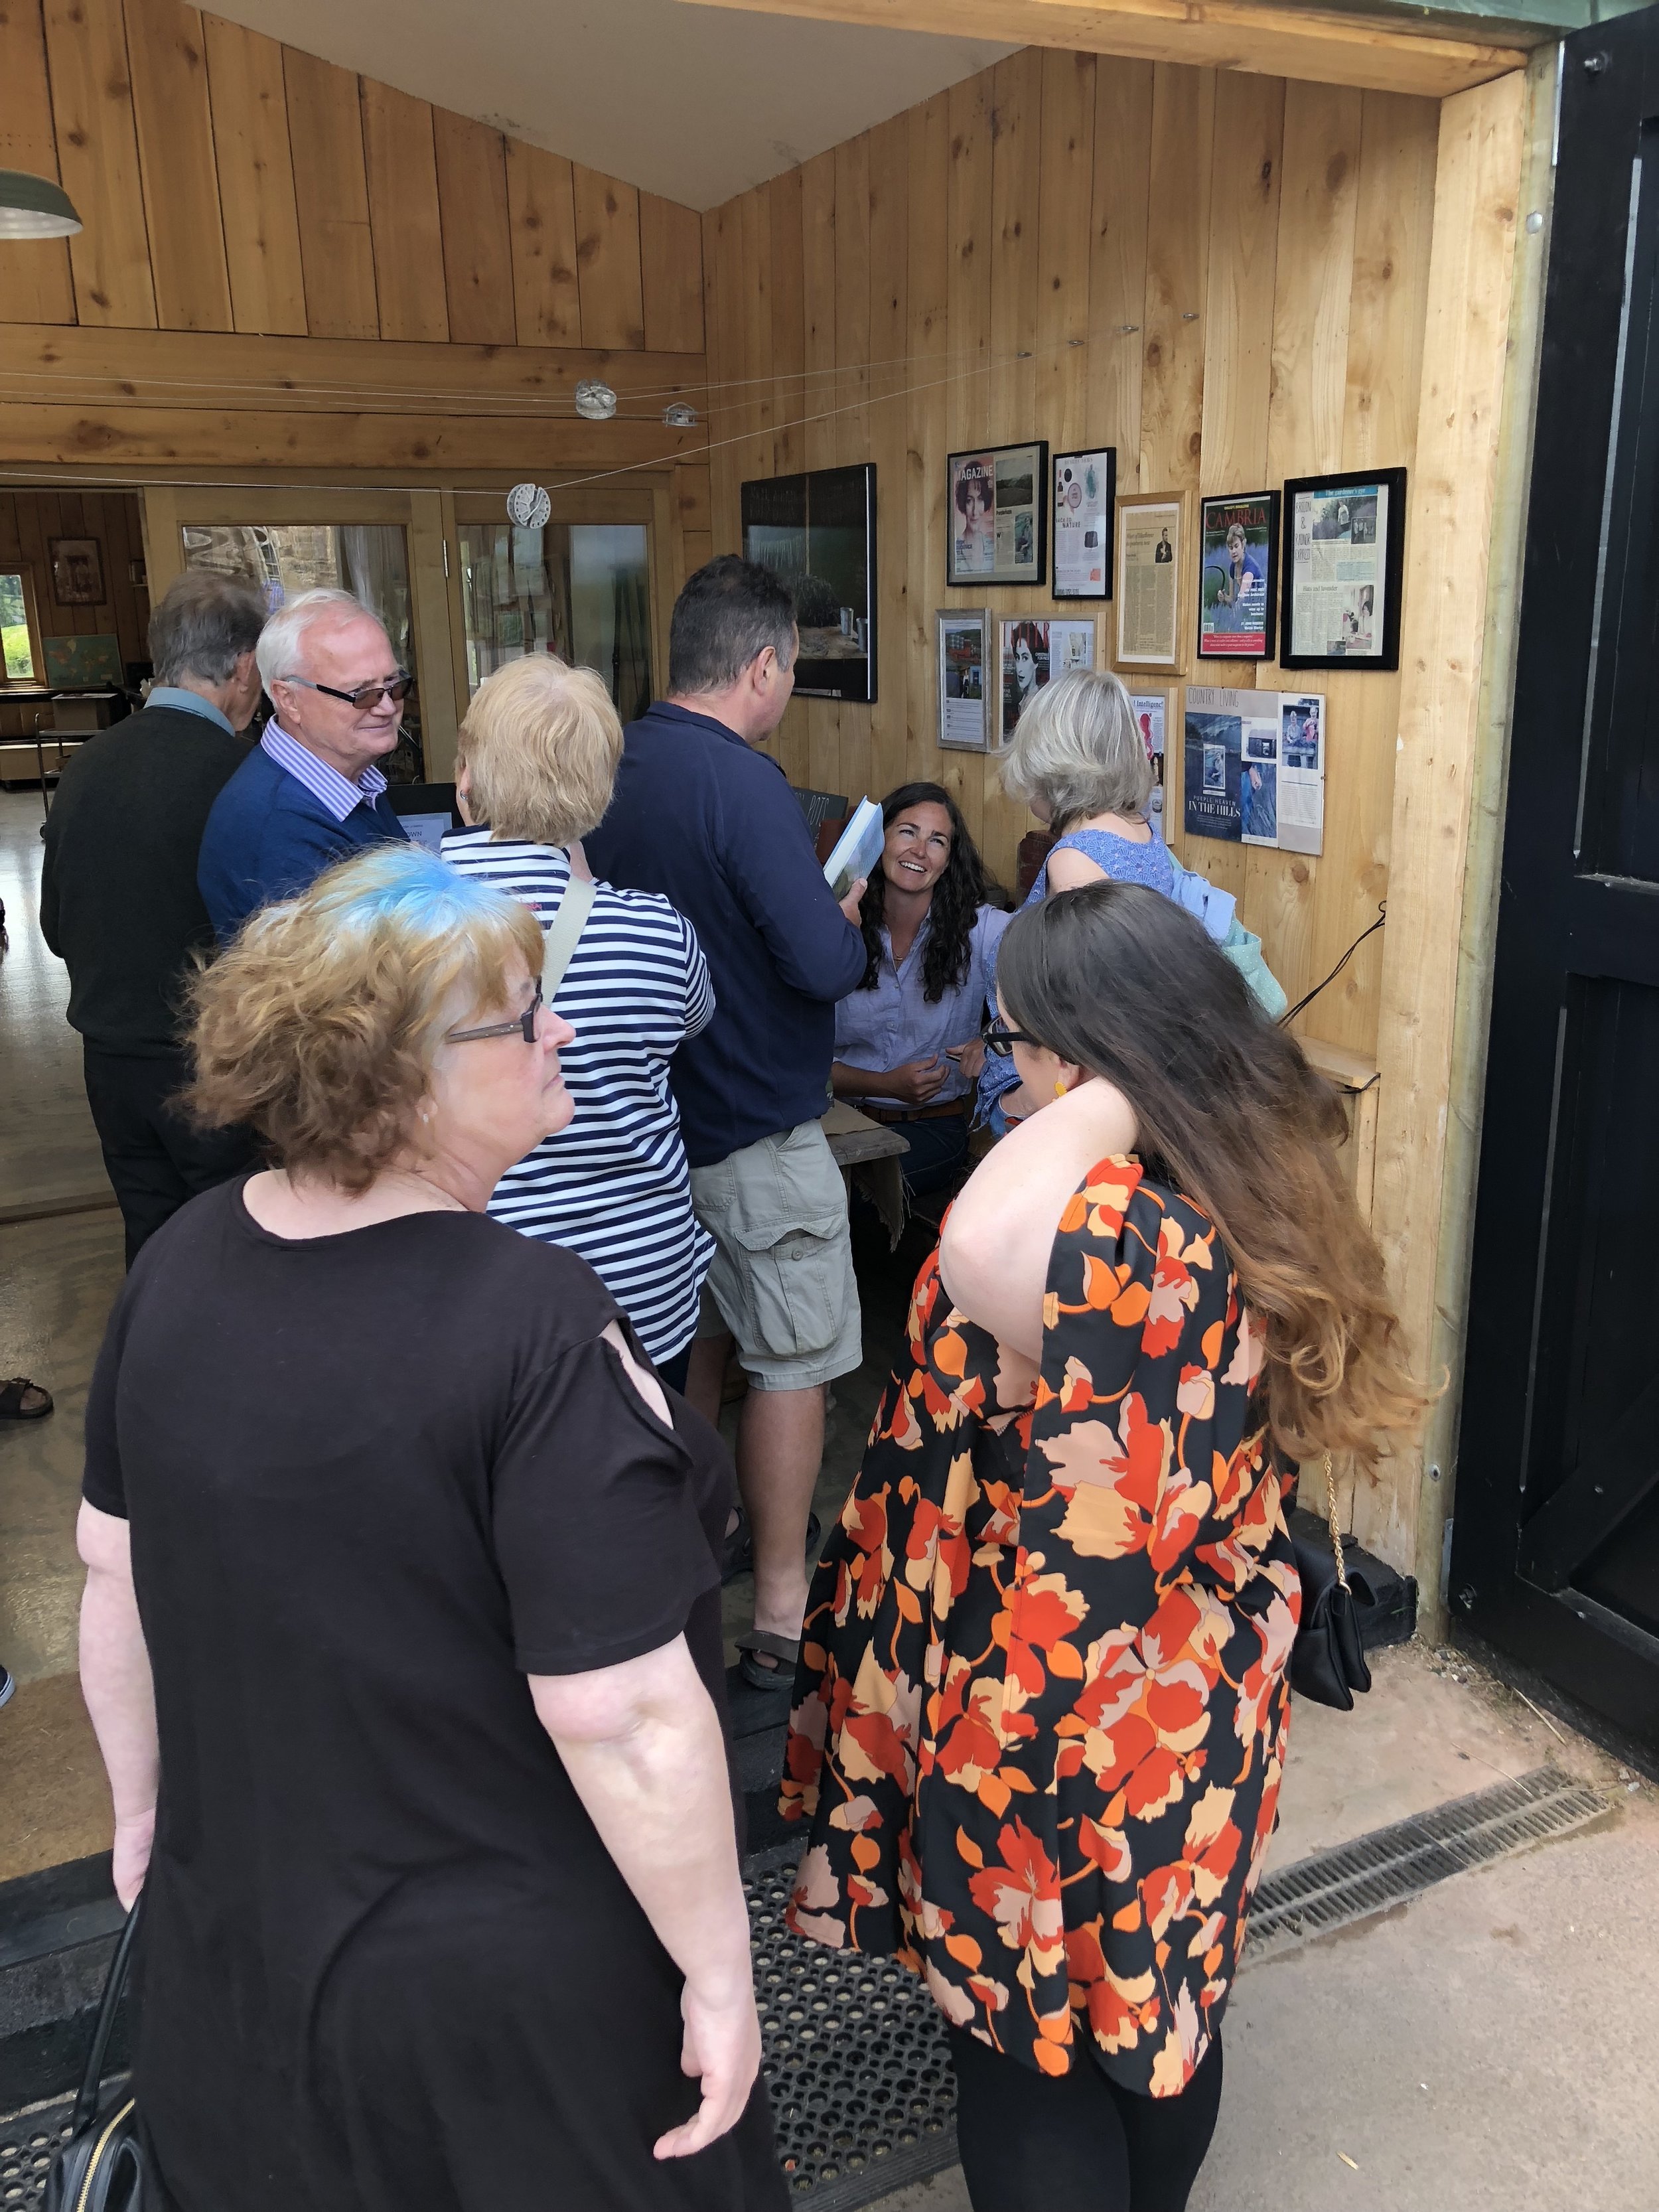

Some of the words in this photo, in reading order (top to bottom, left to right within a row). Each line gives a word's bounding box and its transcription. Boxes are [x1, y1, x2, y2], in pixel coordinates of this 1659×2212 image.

[956, 465, 993, 481] MAGAZINE
[1206, 508, 1266, 530] CAMBRIA
[1301, 517, 1307, 529] &
[1189, 688, 1214, 705] COUNTRY
[1219, 690, 1239, 708] LIVING
[1189, 800, 1196, 810] IN
[1198, 802, 1216, 814] THE
[1216, 804, 1241, 818] HILLS
[1215, 798, 1236, 806] HEAVEN
